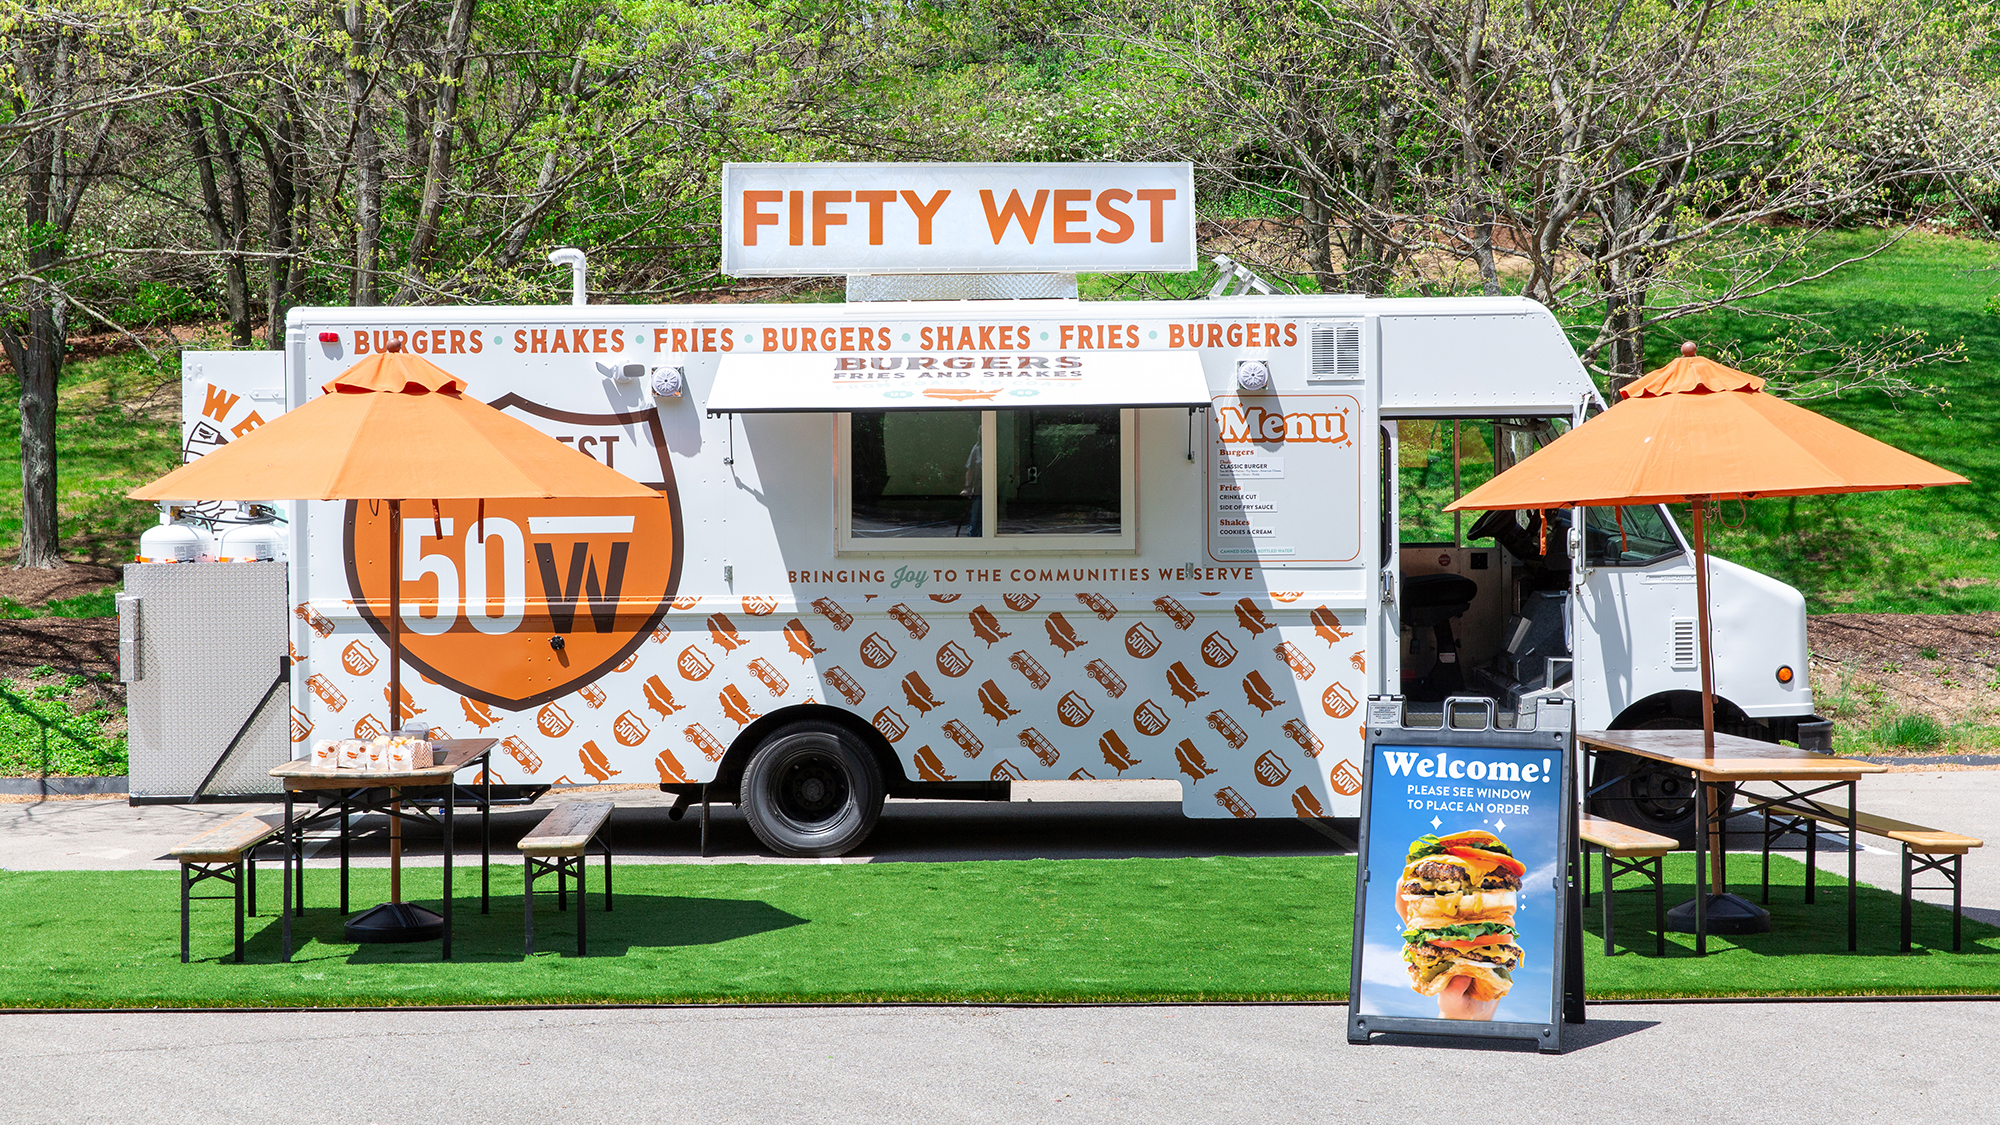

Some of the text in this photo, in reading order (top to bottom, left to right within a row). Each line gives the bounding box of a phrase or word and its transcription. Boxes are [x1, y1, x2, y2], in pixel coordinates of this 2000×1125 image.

[743, 189, 1176, 246] FIFTY WEST
[354, 323, 1298, 355] BURGERS SHAKES FRIES BURGERS SHAKES FRIES BURGERS
[833, 356, 1083, 370] BURGERS
[1220, 407, 1348, 443] Menu
[1219, 448, 1255, 456] Burgers
[1219, 484, 1242, 492] Fries
[1219, 518, 1250, 527] Shakes
[401, 516, 635, 635] 50W
[788, 565, 1253, 589] BRINGING Joy TO THE COMMUNITIES WE SERVE
[863, 642, 889, 667] 50W
[1128, 631, 1154, 656] 50W
[1204, 641, 1230, 666] 50W
[344, 649, 370, 674] 50W
[680, 654, 706, 679] 50W
[939, 650, 965, 675] 50W
[1060, 700, 1086, 725] 50W
[1325, 691, 1351, 716] 50W
[540, 711, 566, 736] 50W
[616, 719, 642, 744] 50W
[875, 716, 901, 741] 50W
[1136, 709, 1162, 734] 50W
[1257, 760, 1283, 785] 50W
[1383, 751, 1551, 783] Welcome!
[1333, 769, 1359, 794] 50W
[1407, 785, 1531, 799] PLEASE SEE WINDOW
[1407, 799, 1530, 814] TO PLACE AN ORDER
